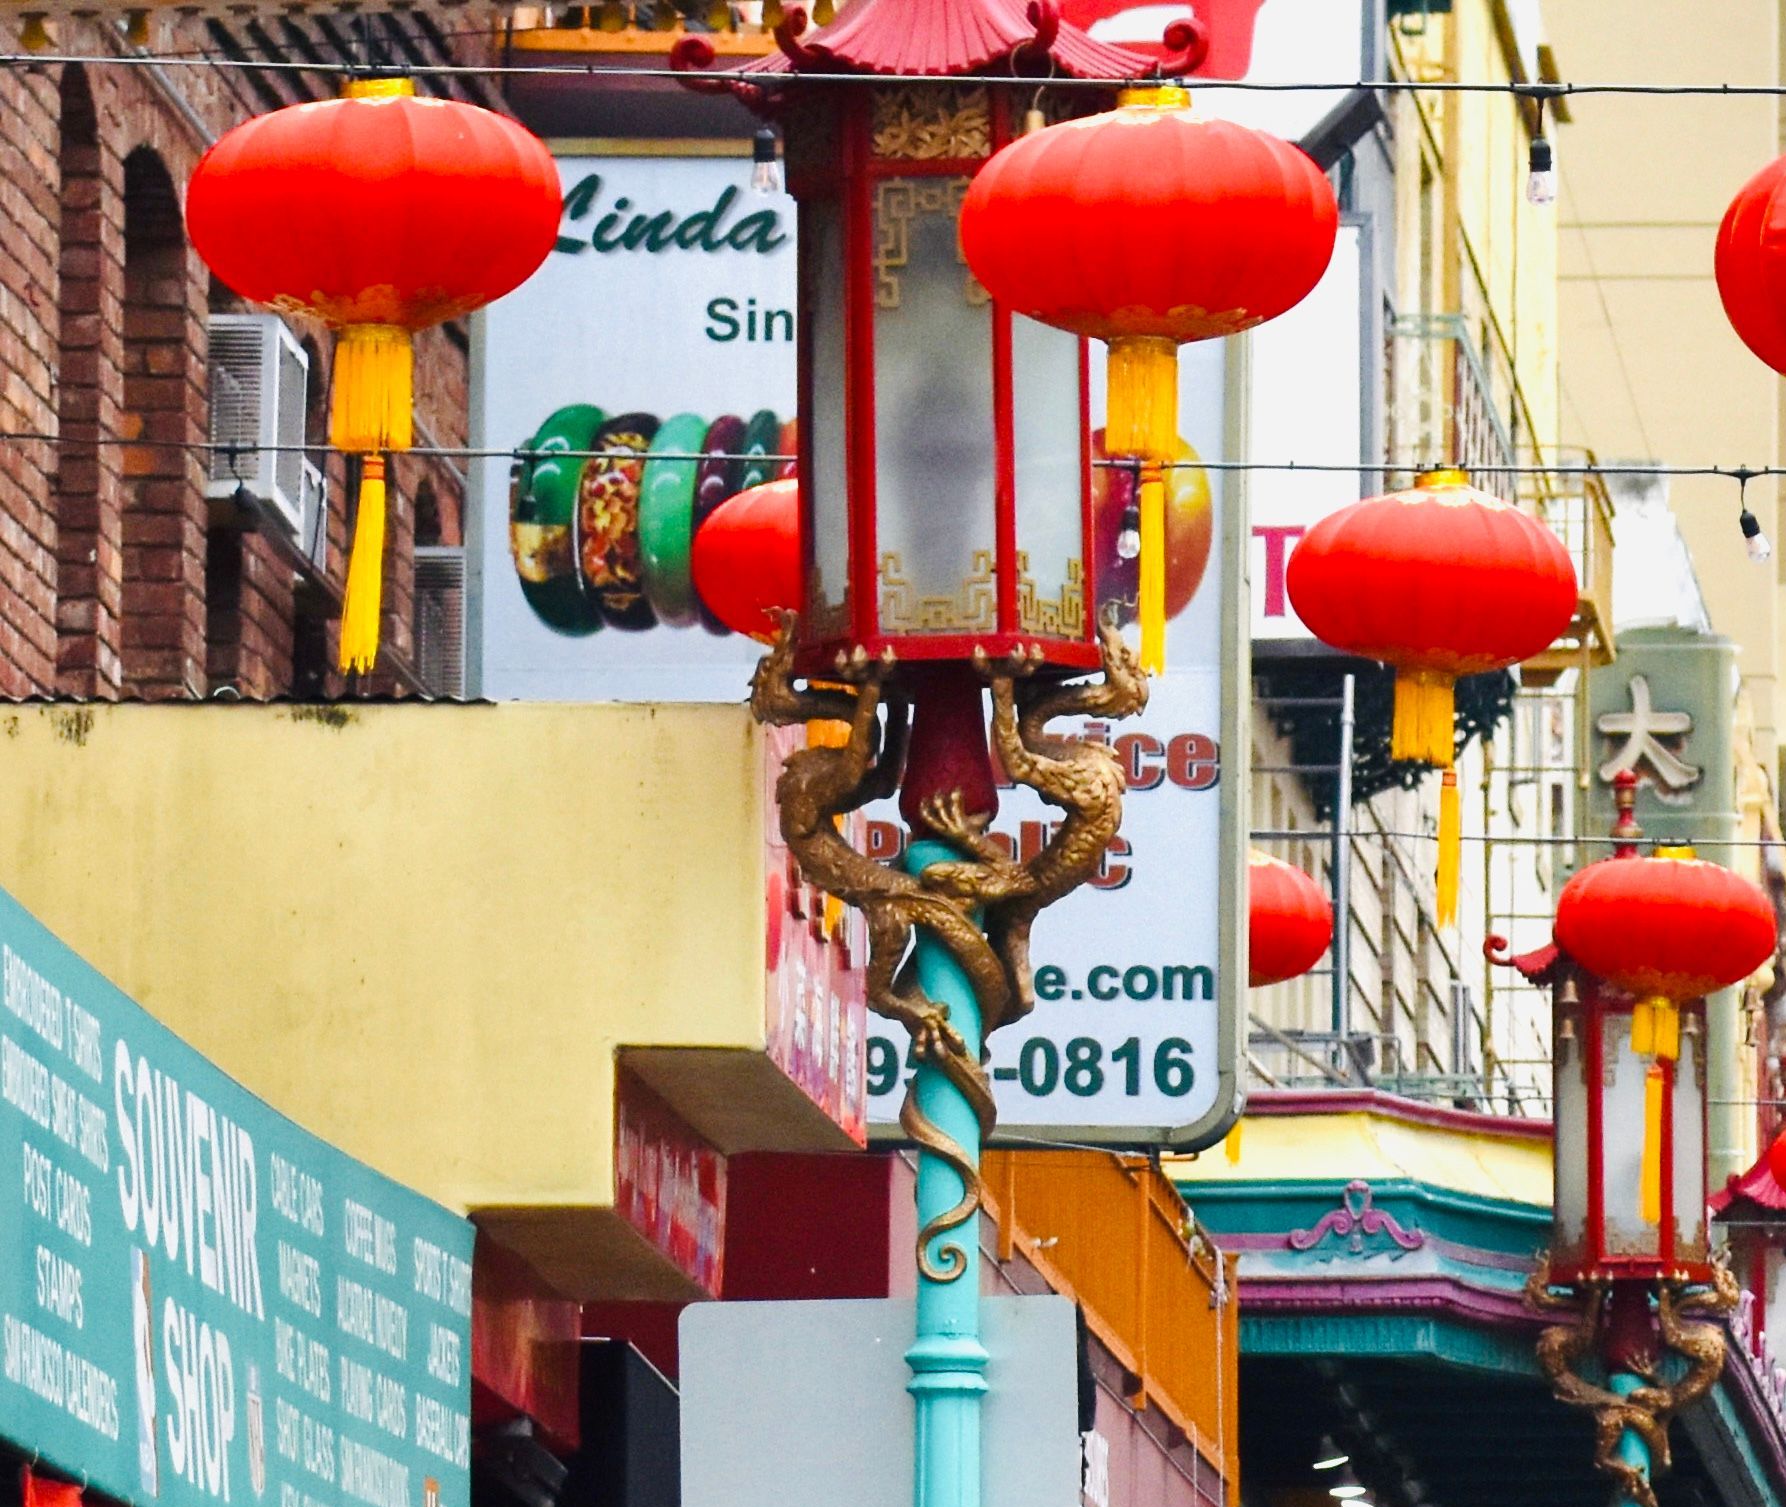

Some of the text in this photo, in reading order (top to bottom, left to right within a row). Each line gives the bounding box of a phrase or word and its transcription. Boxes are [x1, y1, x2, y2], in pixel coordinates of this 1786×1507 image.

[557, 174, 787, 256] Linda
[705, 297, 797, 344] Sin
[1598, 674, 1700, 788] 大
[23, 1140, 92, 1248] POST CARDS
[114, 1038, 265, 1322] SOUVENIR
[36, 1244, 84, 1330] STAMPS
[163, 1296, 236, 1503] SHOP
